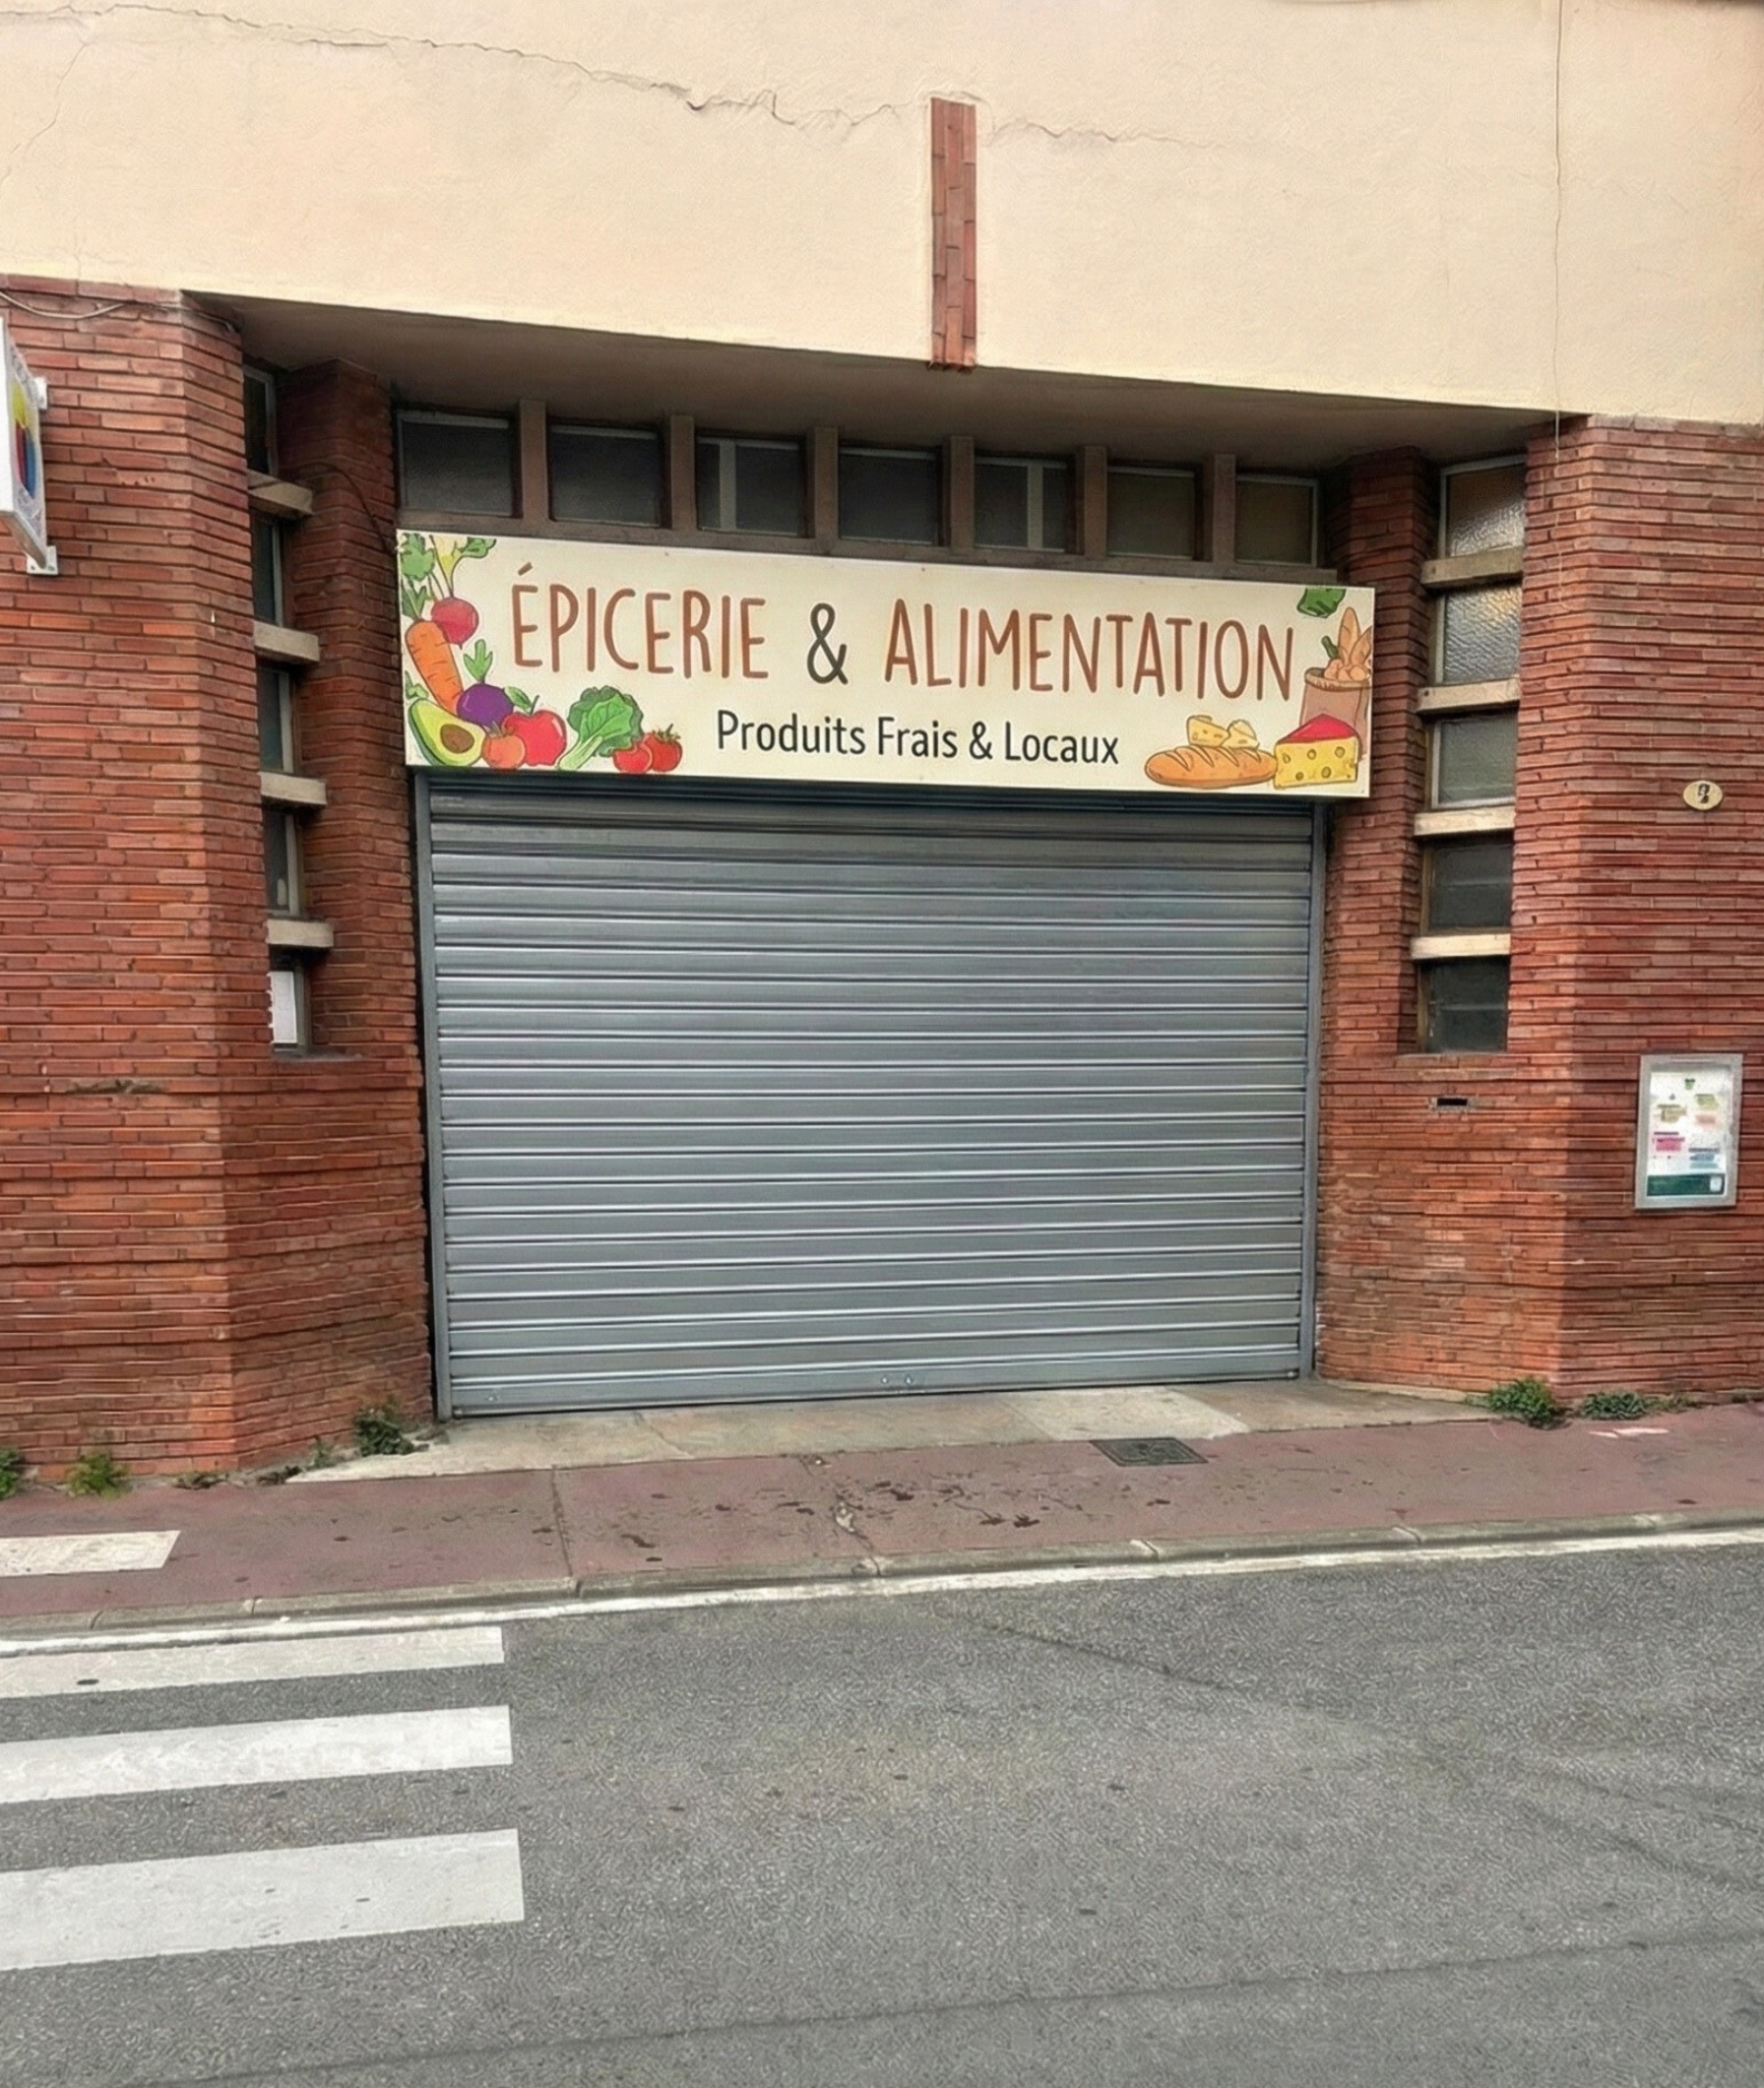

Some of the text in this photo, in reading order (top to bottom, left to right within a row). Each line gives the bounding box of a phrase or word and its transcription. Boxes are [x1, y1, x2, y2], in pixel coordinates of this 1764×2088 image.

[512, 562, 1293, 701] ÉPICERIE & ALIMENTATION
[718, 710, 1119, 765] Produits Frais & Locaux
